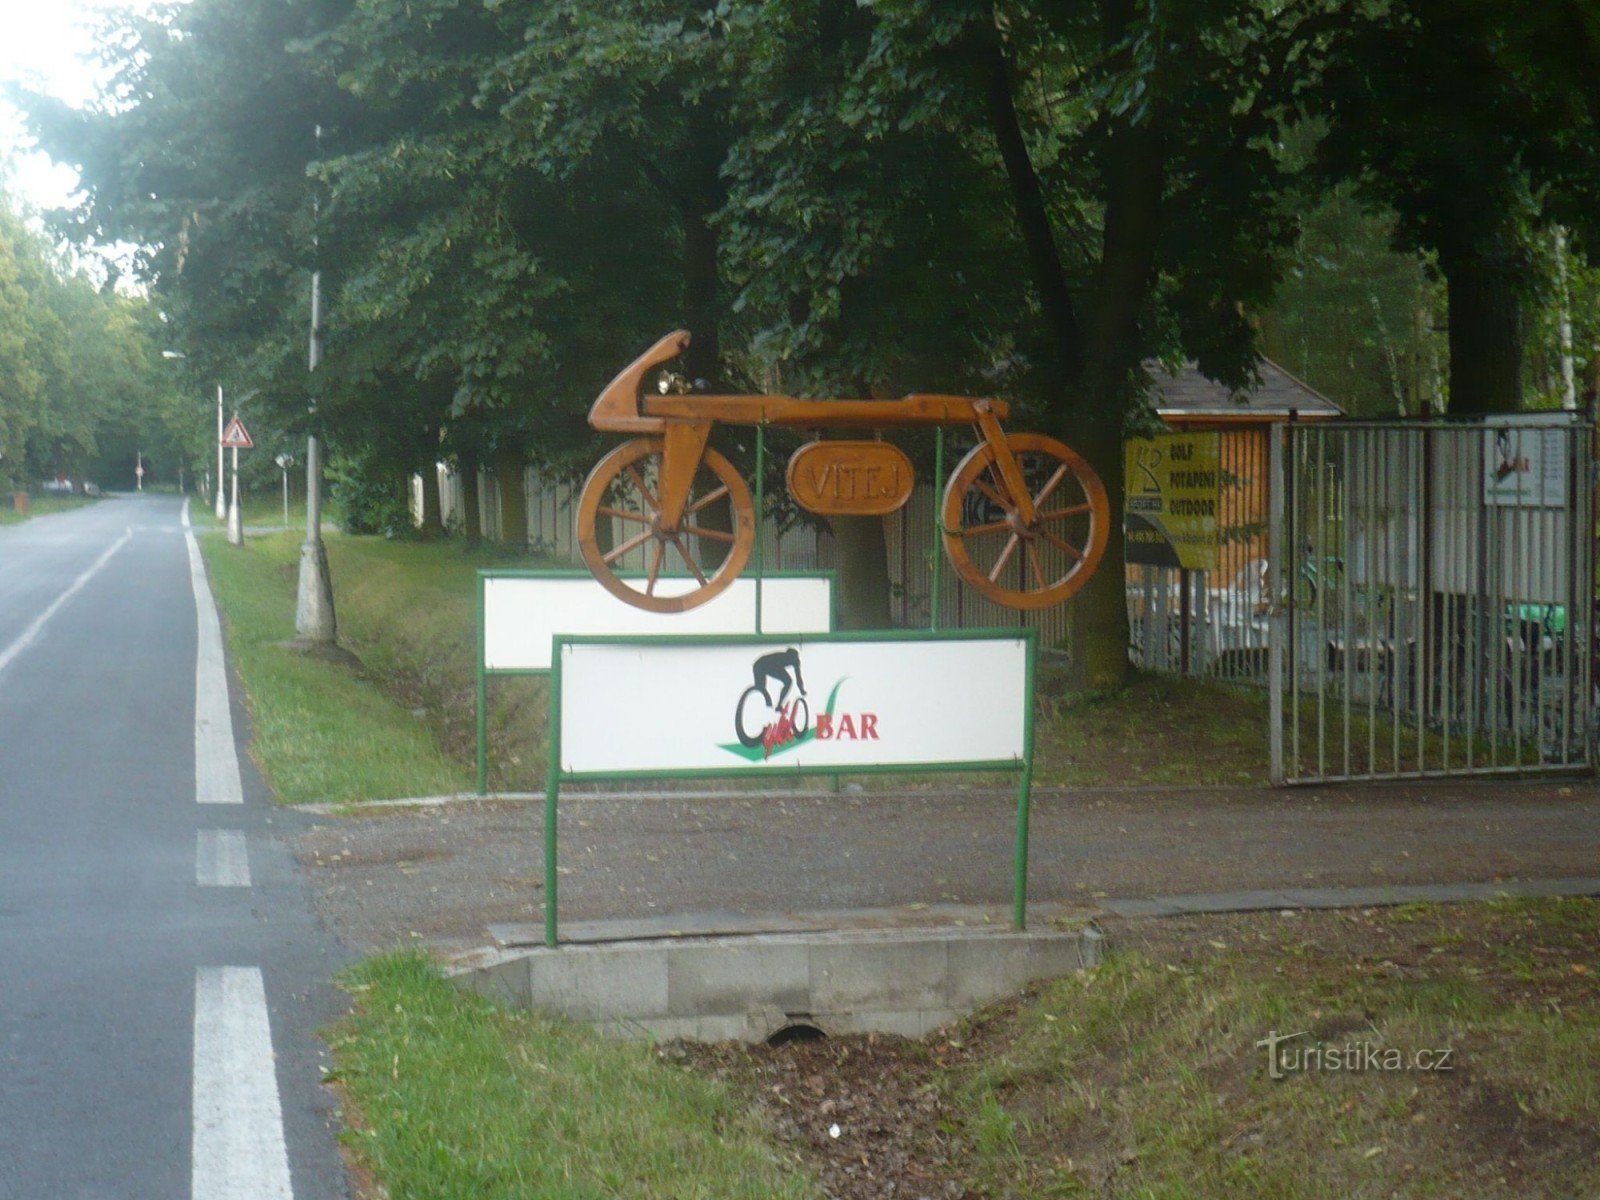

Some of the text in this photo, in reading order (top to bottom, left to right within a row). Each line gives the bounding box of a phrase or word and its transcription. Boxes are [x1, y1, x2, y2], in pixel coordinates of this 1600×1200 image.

[1170, 443, 1193, 461] GOLF
[1169, 499, 1215, 516] OUTDOOR
[816, 713, 880, 741] BAR
